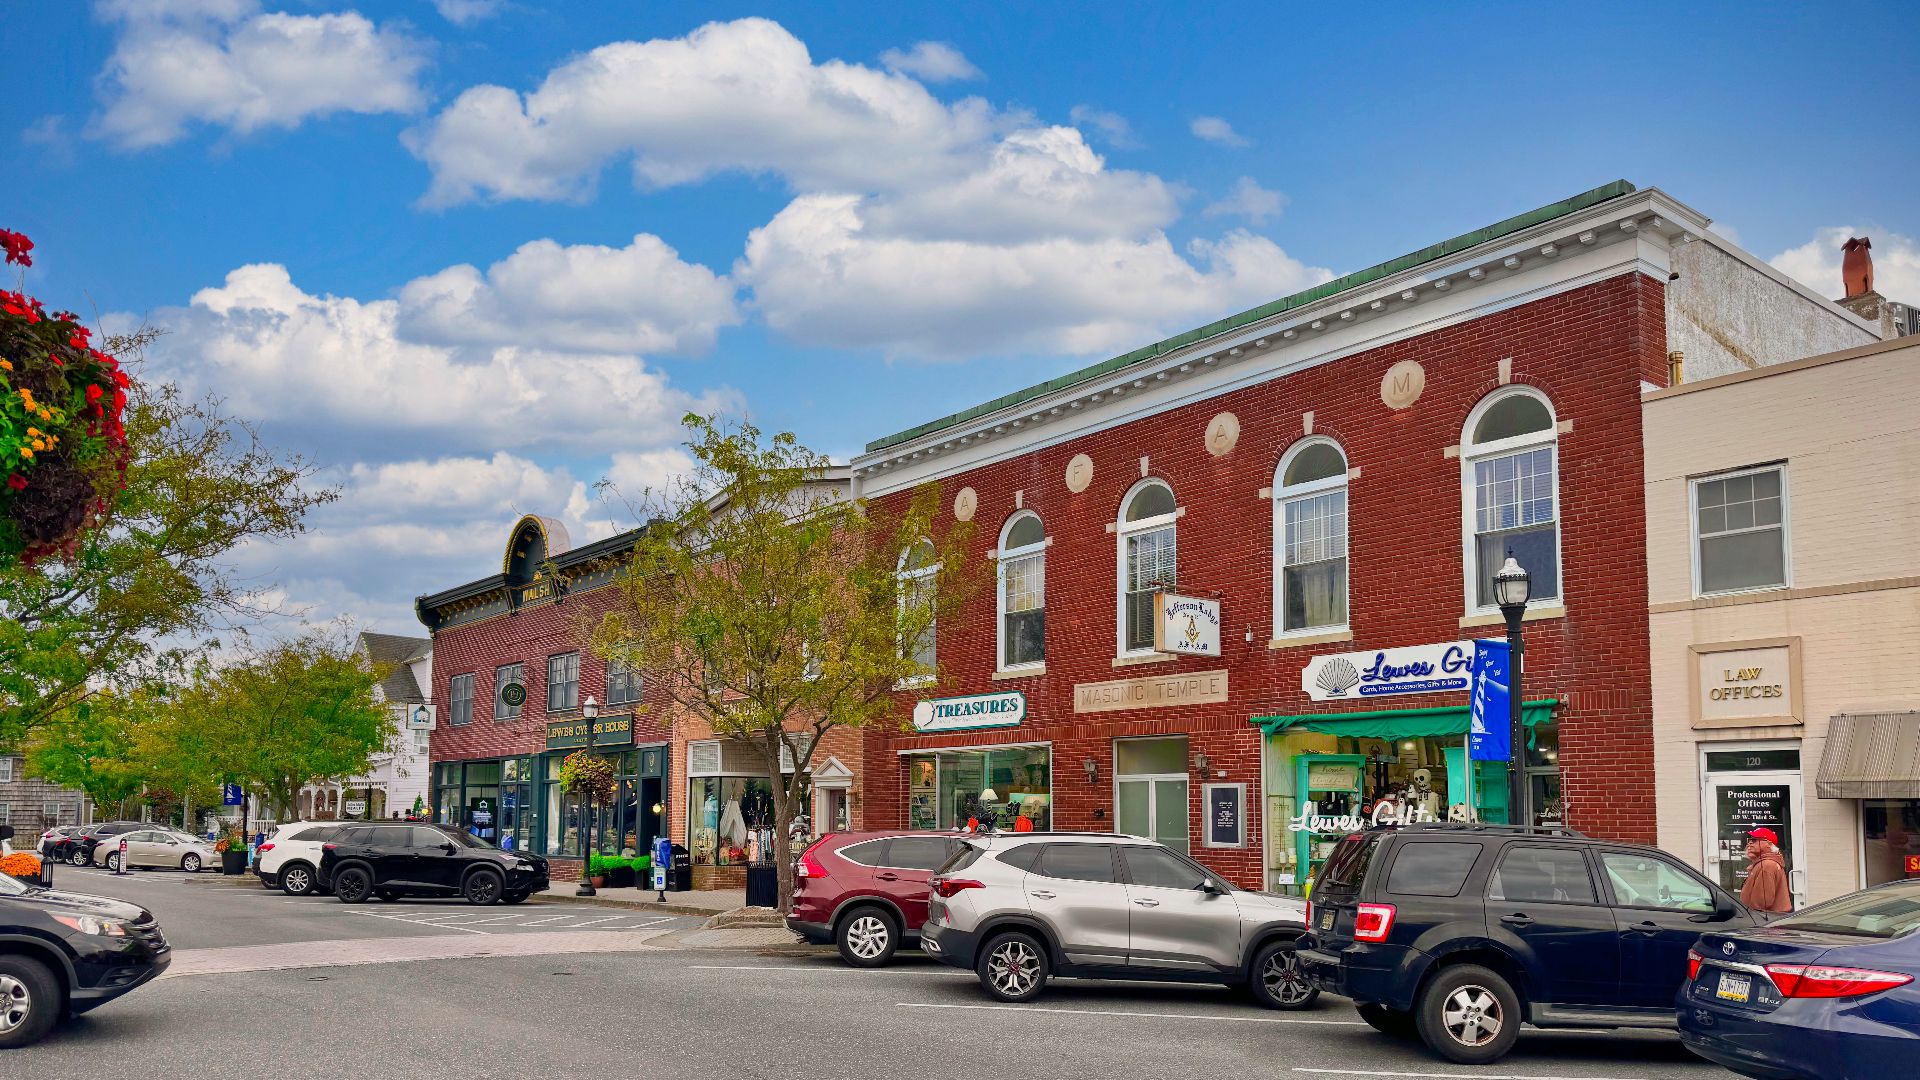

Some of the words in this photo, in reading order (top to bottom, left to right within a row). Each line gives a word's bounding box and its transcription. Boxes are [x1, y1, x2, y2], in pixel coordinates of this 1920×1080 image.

[1393, 372, 1410, 396] M
[1213, 424, 1229, 443] A
[1073, 463, 1084, 482] F
[960, 496, 970, 511] A
[522, 584, 550, 602] WALSH
[1361, 651, 1436, 682] Lewes
[1724, 667, 1762, 682] LAW
[1081, 684, 1144, 706] MASONIC
[1155, 677, 1220, 699] TEMPLE
[1394, 682, 1427, 690] Accessories,
[1709, 684, 1783, 701] OFFICES
[936, 697, 1019, 718] TREASURES
[547, 726, 574, 738] LEWES
[575, 723, 603, 736] OYSER
[605, 720, 629, 733] HOUSE
[1745, 757, 1761, 766] 120
[1727, 790, 1780, 799] Professional
[1737, 799, 1770, 807] Offices
[1288, 800, 1364, 834] Lewes
